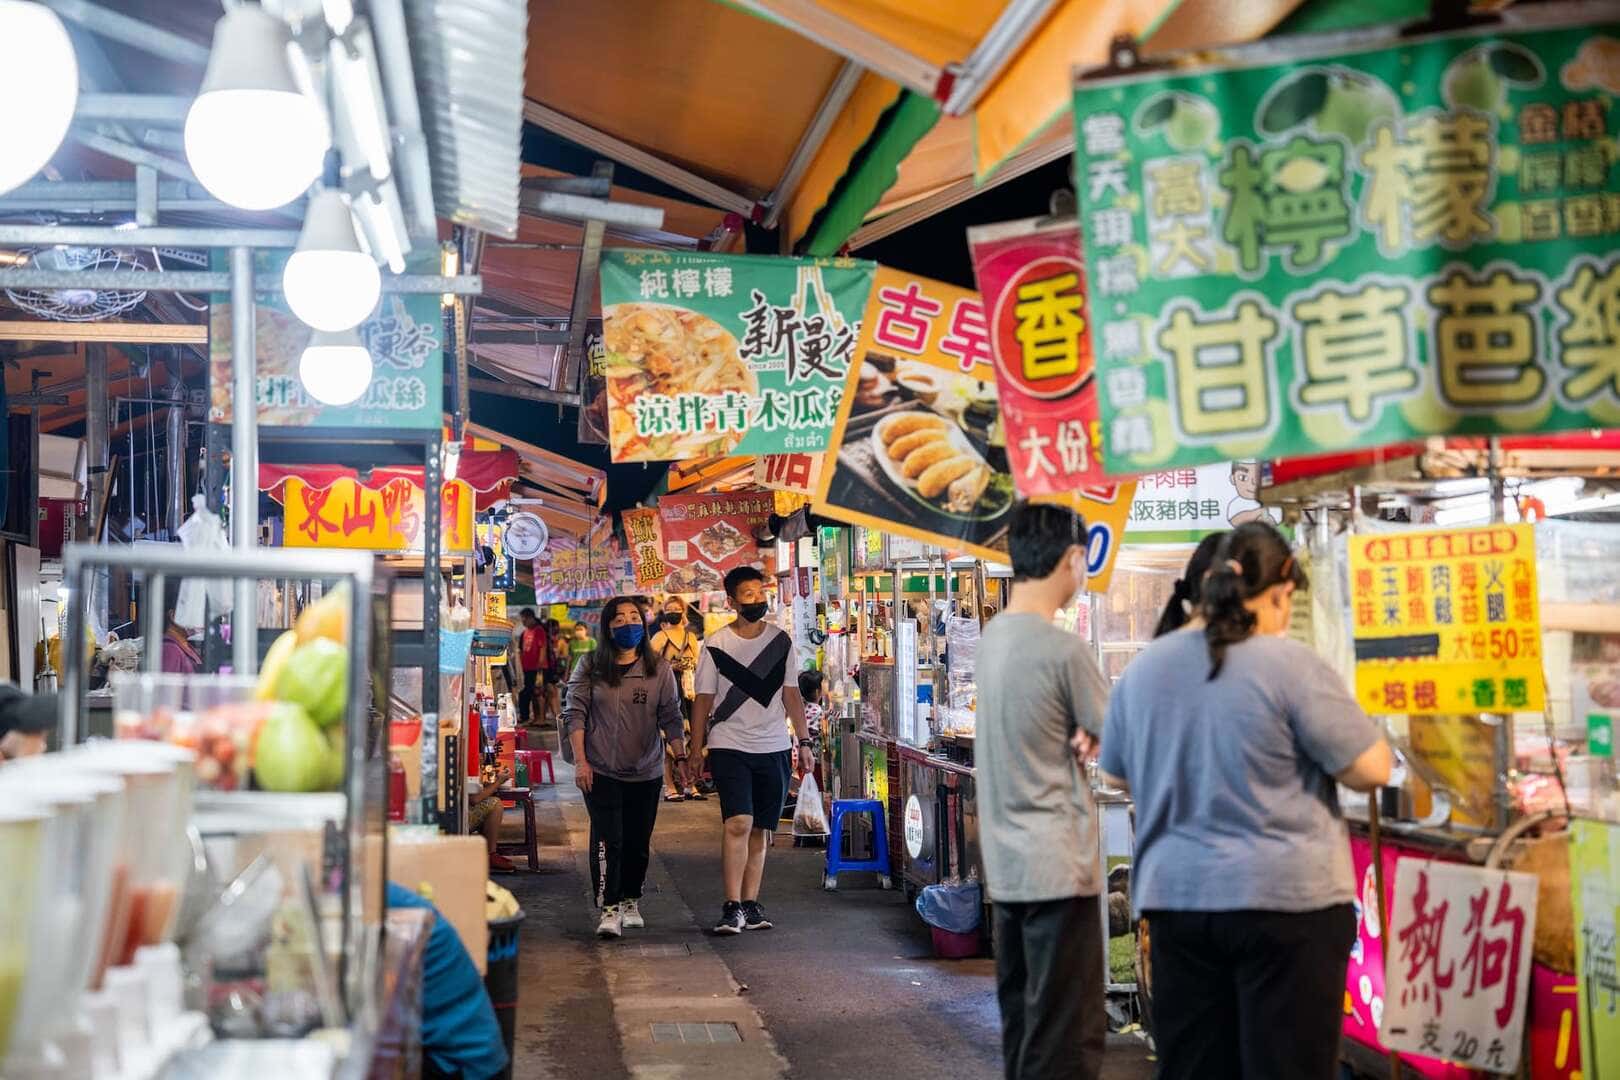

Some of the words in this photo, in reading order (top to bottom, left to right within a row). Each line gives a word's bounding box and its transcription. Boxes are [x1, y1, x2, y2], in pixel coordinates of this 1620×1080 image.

[640, 268, 733, 298] 純檸檬
[1014, 272, 1086, 381] 香
[1129, 498, 1220, 520] 阪豬肉串
[632, 692, 648, 705] 23
[1398, 870, 1526, 1030] 熱狗
